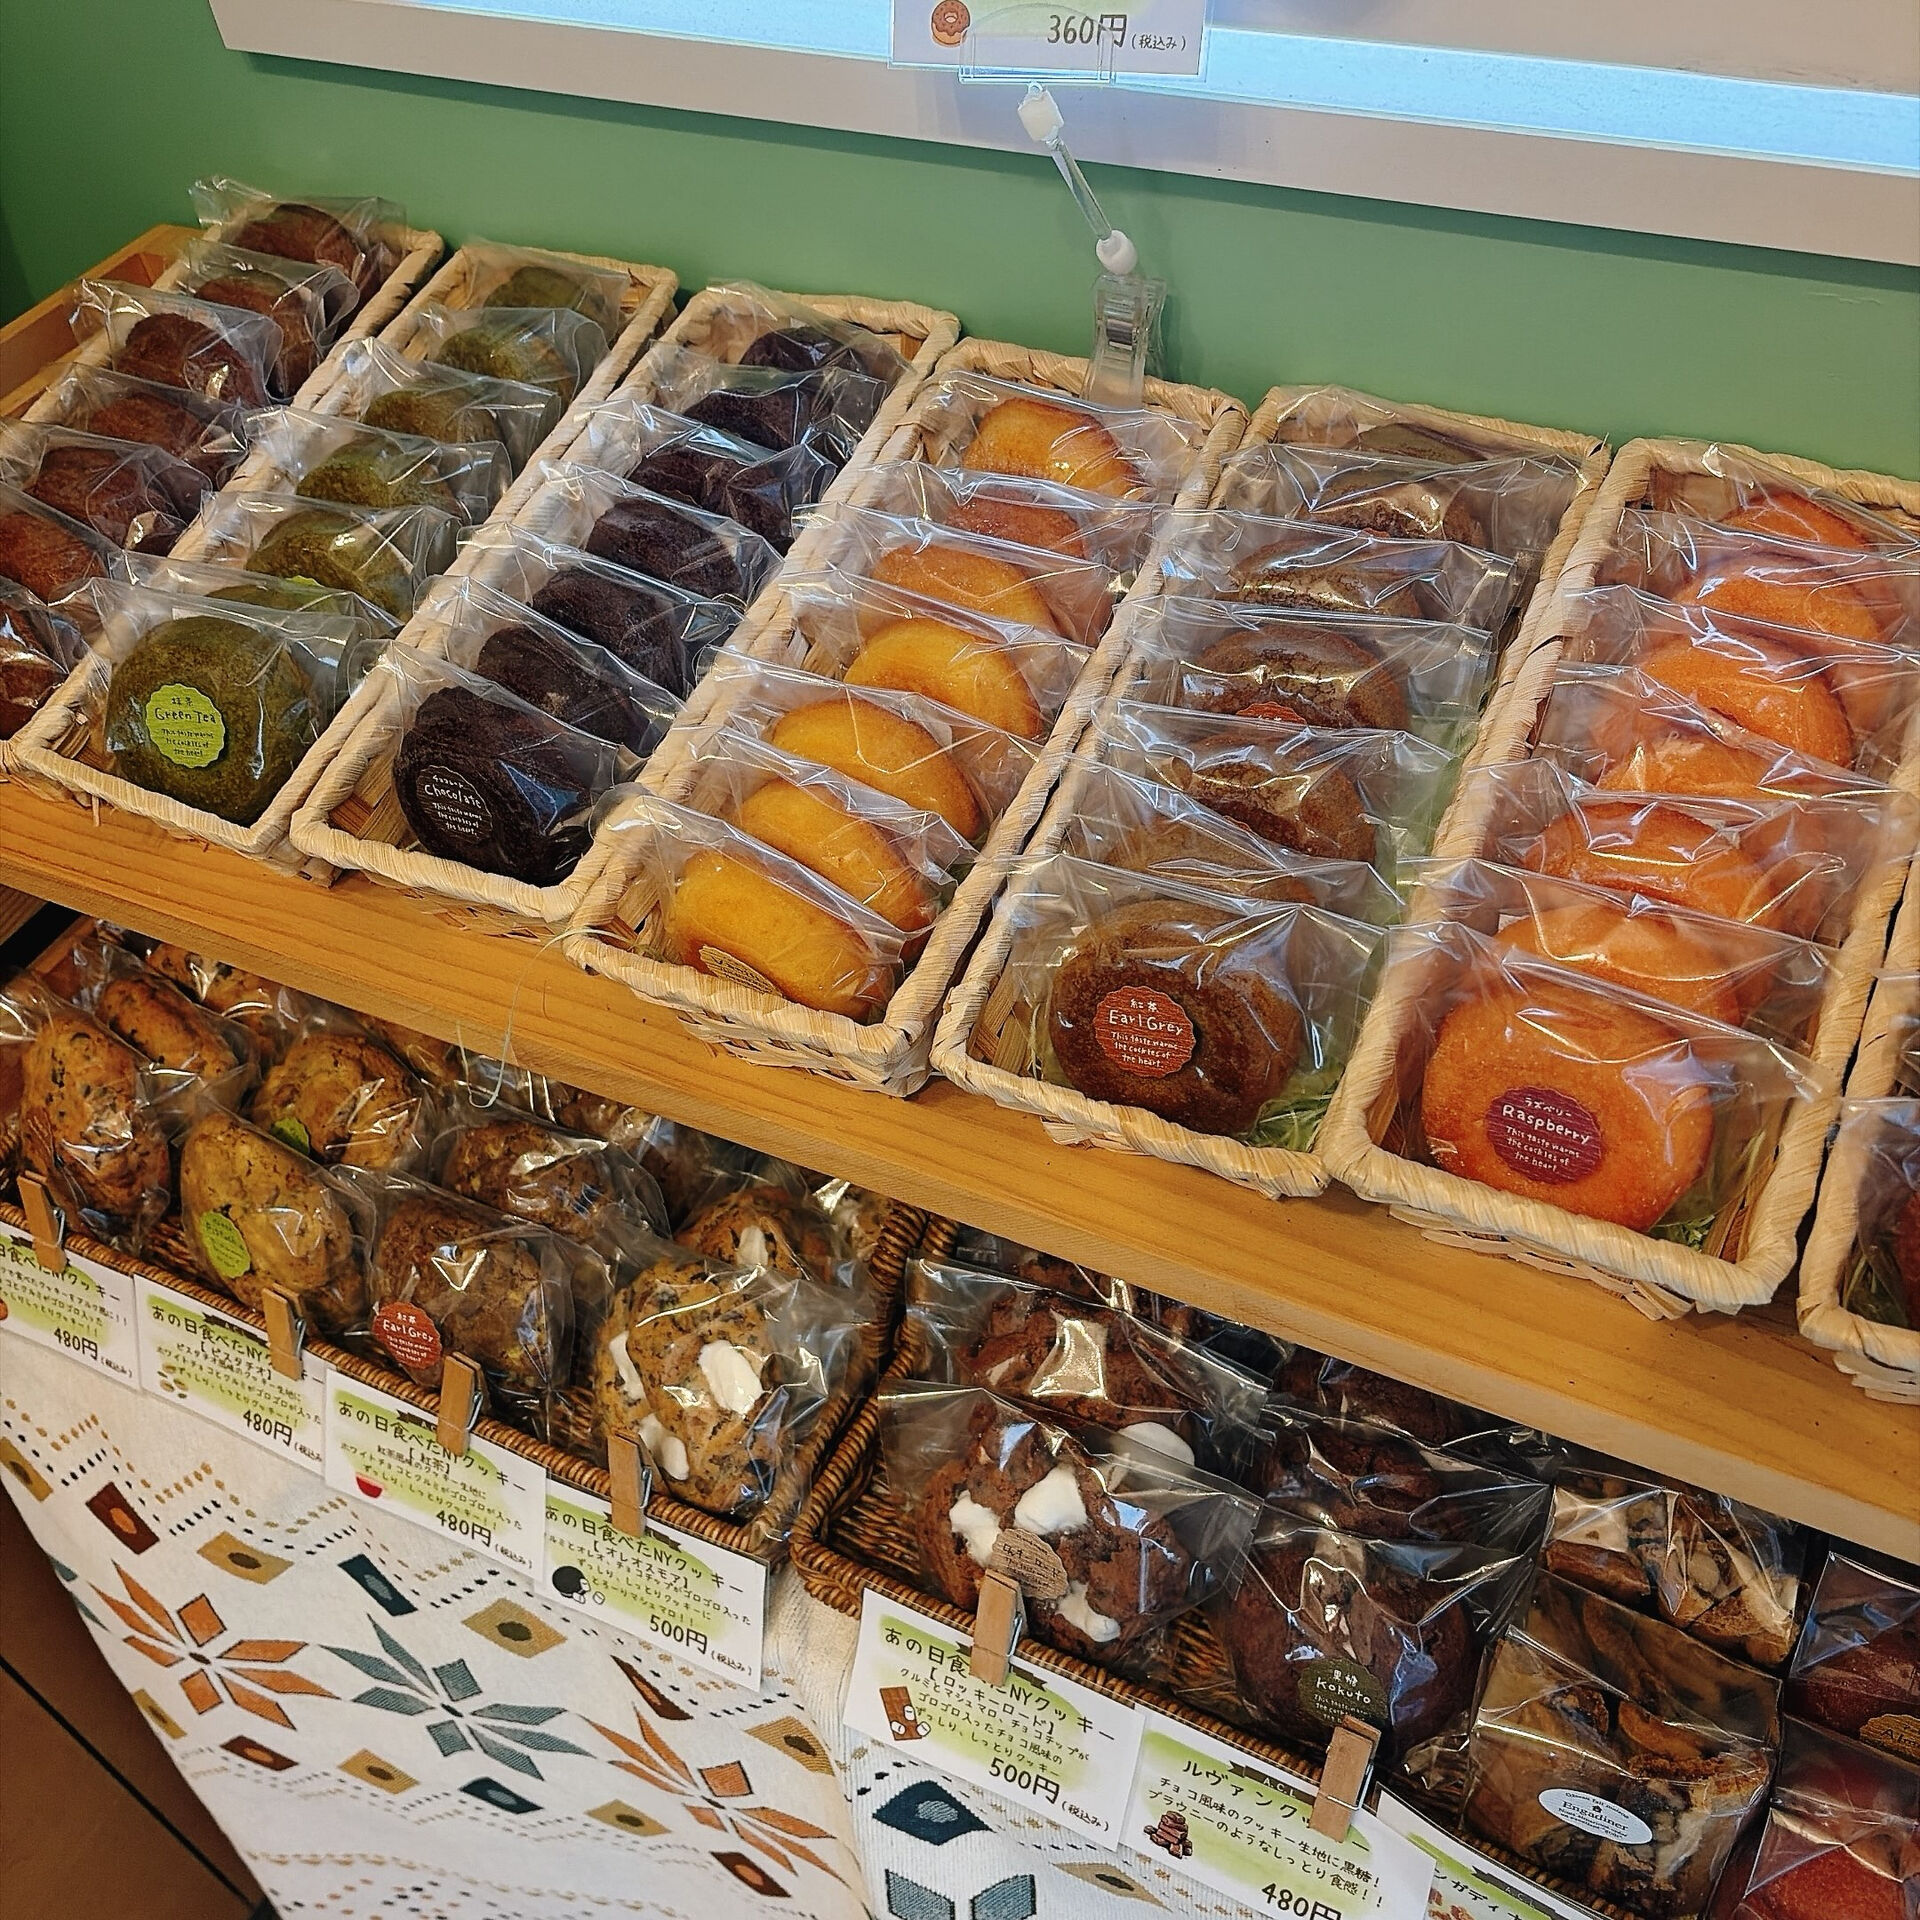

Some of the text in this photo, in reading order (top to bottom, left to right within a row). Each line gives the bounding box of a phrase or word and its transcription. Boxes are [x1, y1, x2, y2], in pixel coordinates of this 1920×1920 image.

[1047, 14, 1127, 48] 360円
[155, 707, 216, 724] Green Tea
[424, 783, 481, 809] Chocolate
[1109, 1010, 1183, 1036] Earl Grey
[1111, 1031, 1178, 1049] This taste warms
[1114, 1042, 1126, 1050] the
[1162, 1051, 1171, 1059] of
[1122, 1054, 1136, 1063] the
[1525, 1097, 1571, 1117] ラズベリー
[1502, 1104, 1590, 1145] Raspberry
[1506, 1126, 1580, 1158] This taste warms
[1515, 1151, 1529, 1162] the
[1524, 1145, 1557, 1161] cockles
[1560, 1158, 1570, 1166] of
[54, 1327, 98, 1360] 480円
[383, 1319, 434, 1342] Earl Grey
[243, 1410, 293, 1446] 480円
[436, 1510, 492, 1547] 480円
[545, 1505, 743, 1593] あの日食べたNYクッキー
[544, 1532, 750, 1625] ルミとオレオ、チョコチップがゴロゴロ入った
[650, 1615, 707, 1655] 500円
[918, 1692, 1062, 1765] ゴロゴロ入ったチョコ風味の
[988, 1757, 1110, 1832] 500円 (税込み)
[1562, 1800, 1629, 1830] Engadiner
[1262, 1883, 1342, 1920] 480円
